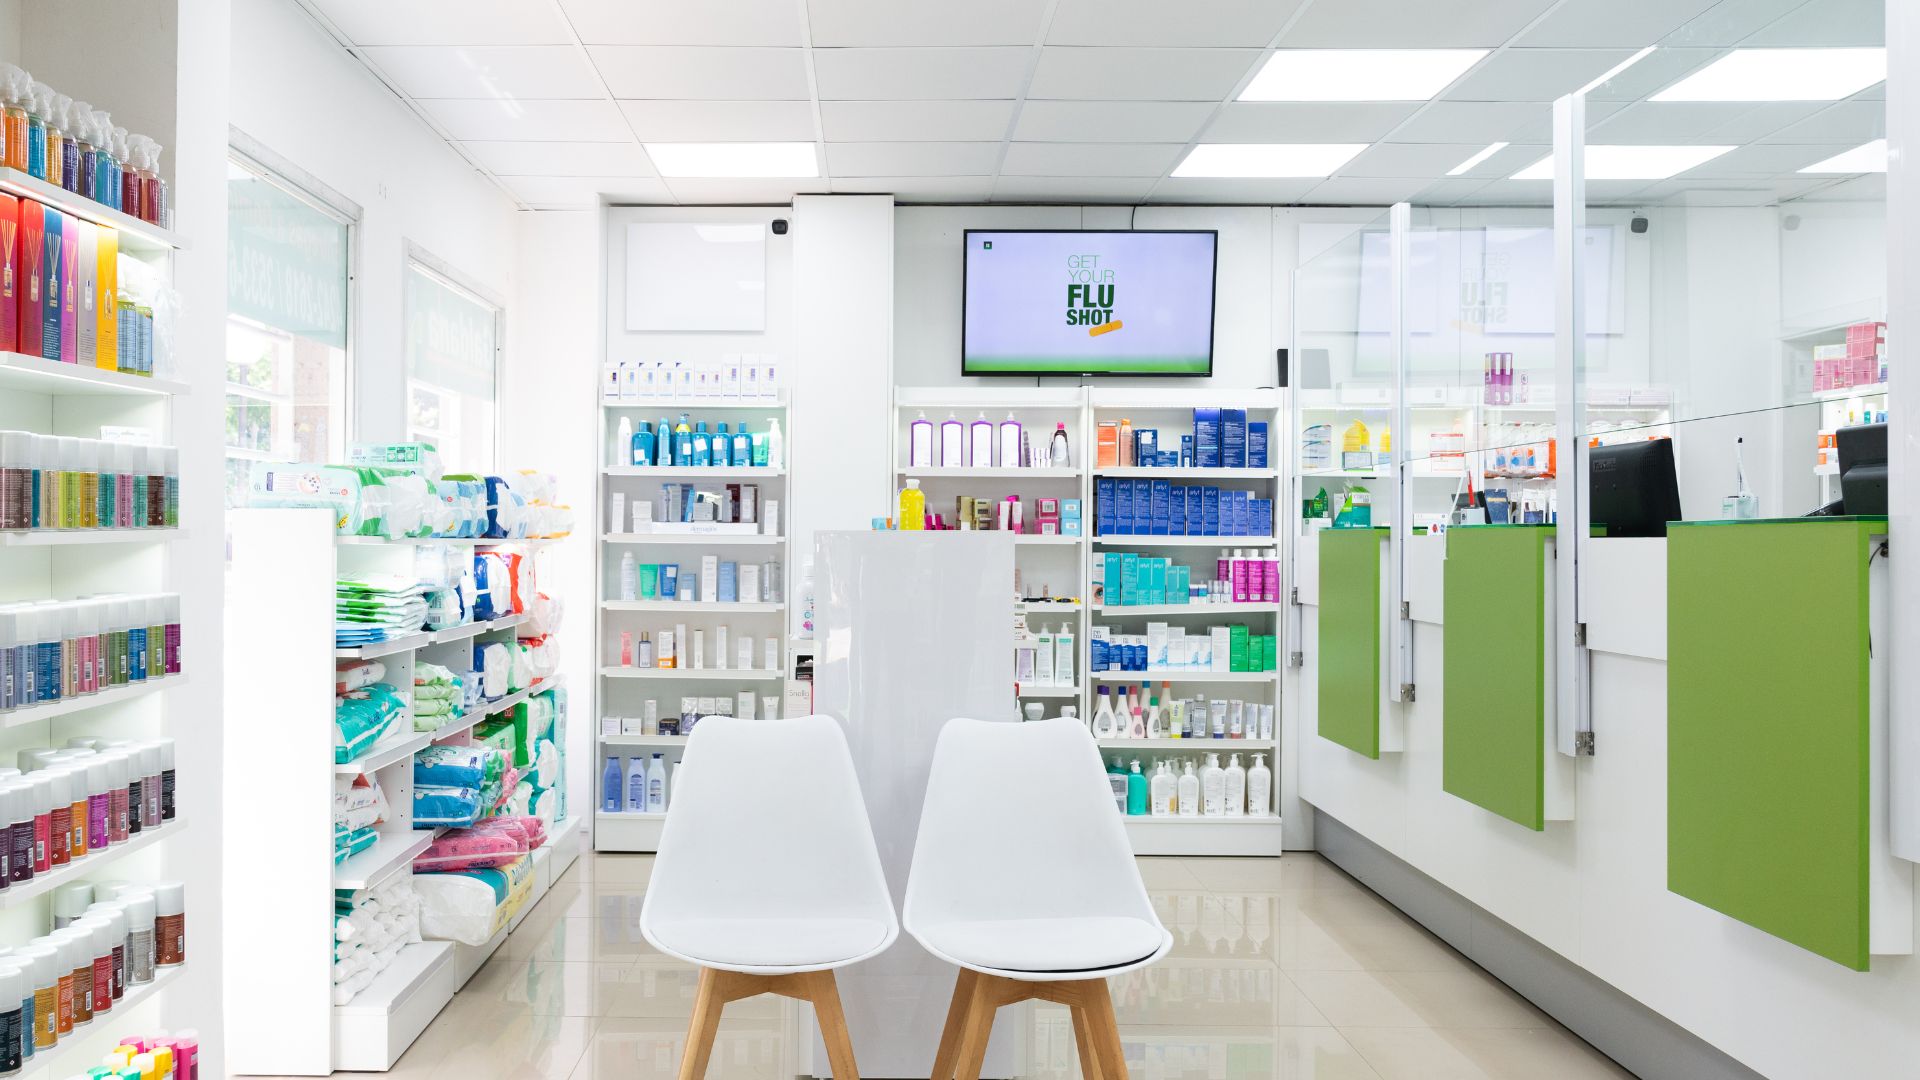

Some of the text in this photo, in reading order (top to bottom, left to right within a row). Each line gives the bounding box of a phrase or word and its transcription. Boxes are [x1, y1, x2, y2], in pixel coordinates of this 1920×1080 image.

[1068, 254, 1101, 268] GET
[1068, 269, 1115, 283] YOUR
[1067, 284, 1115, 308] FLU
[1066, 309, 1113, 325] SHOT
